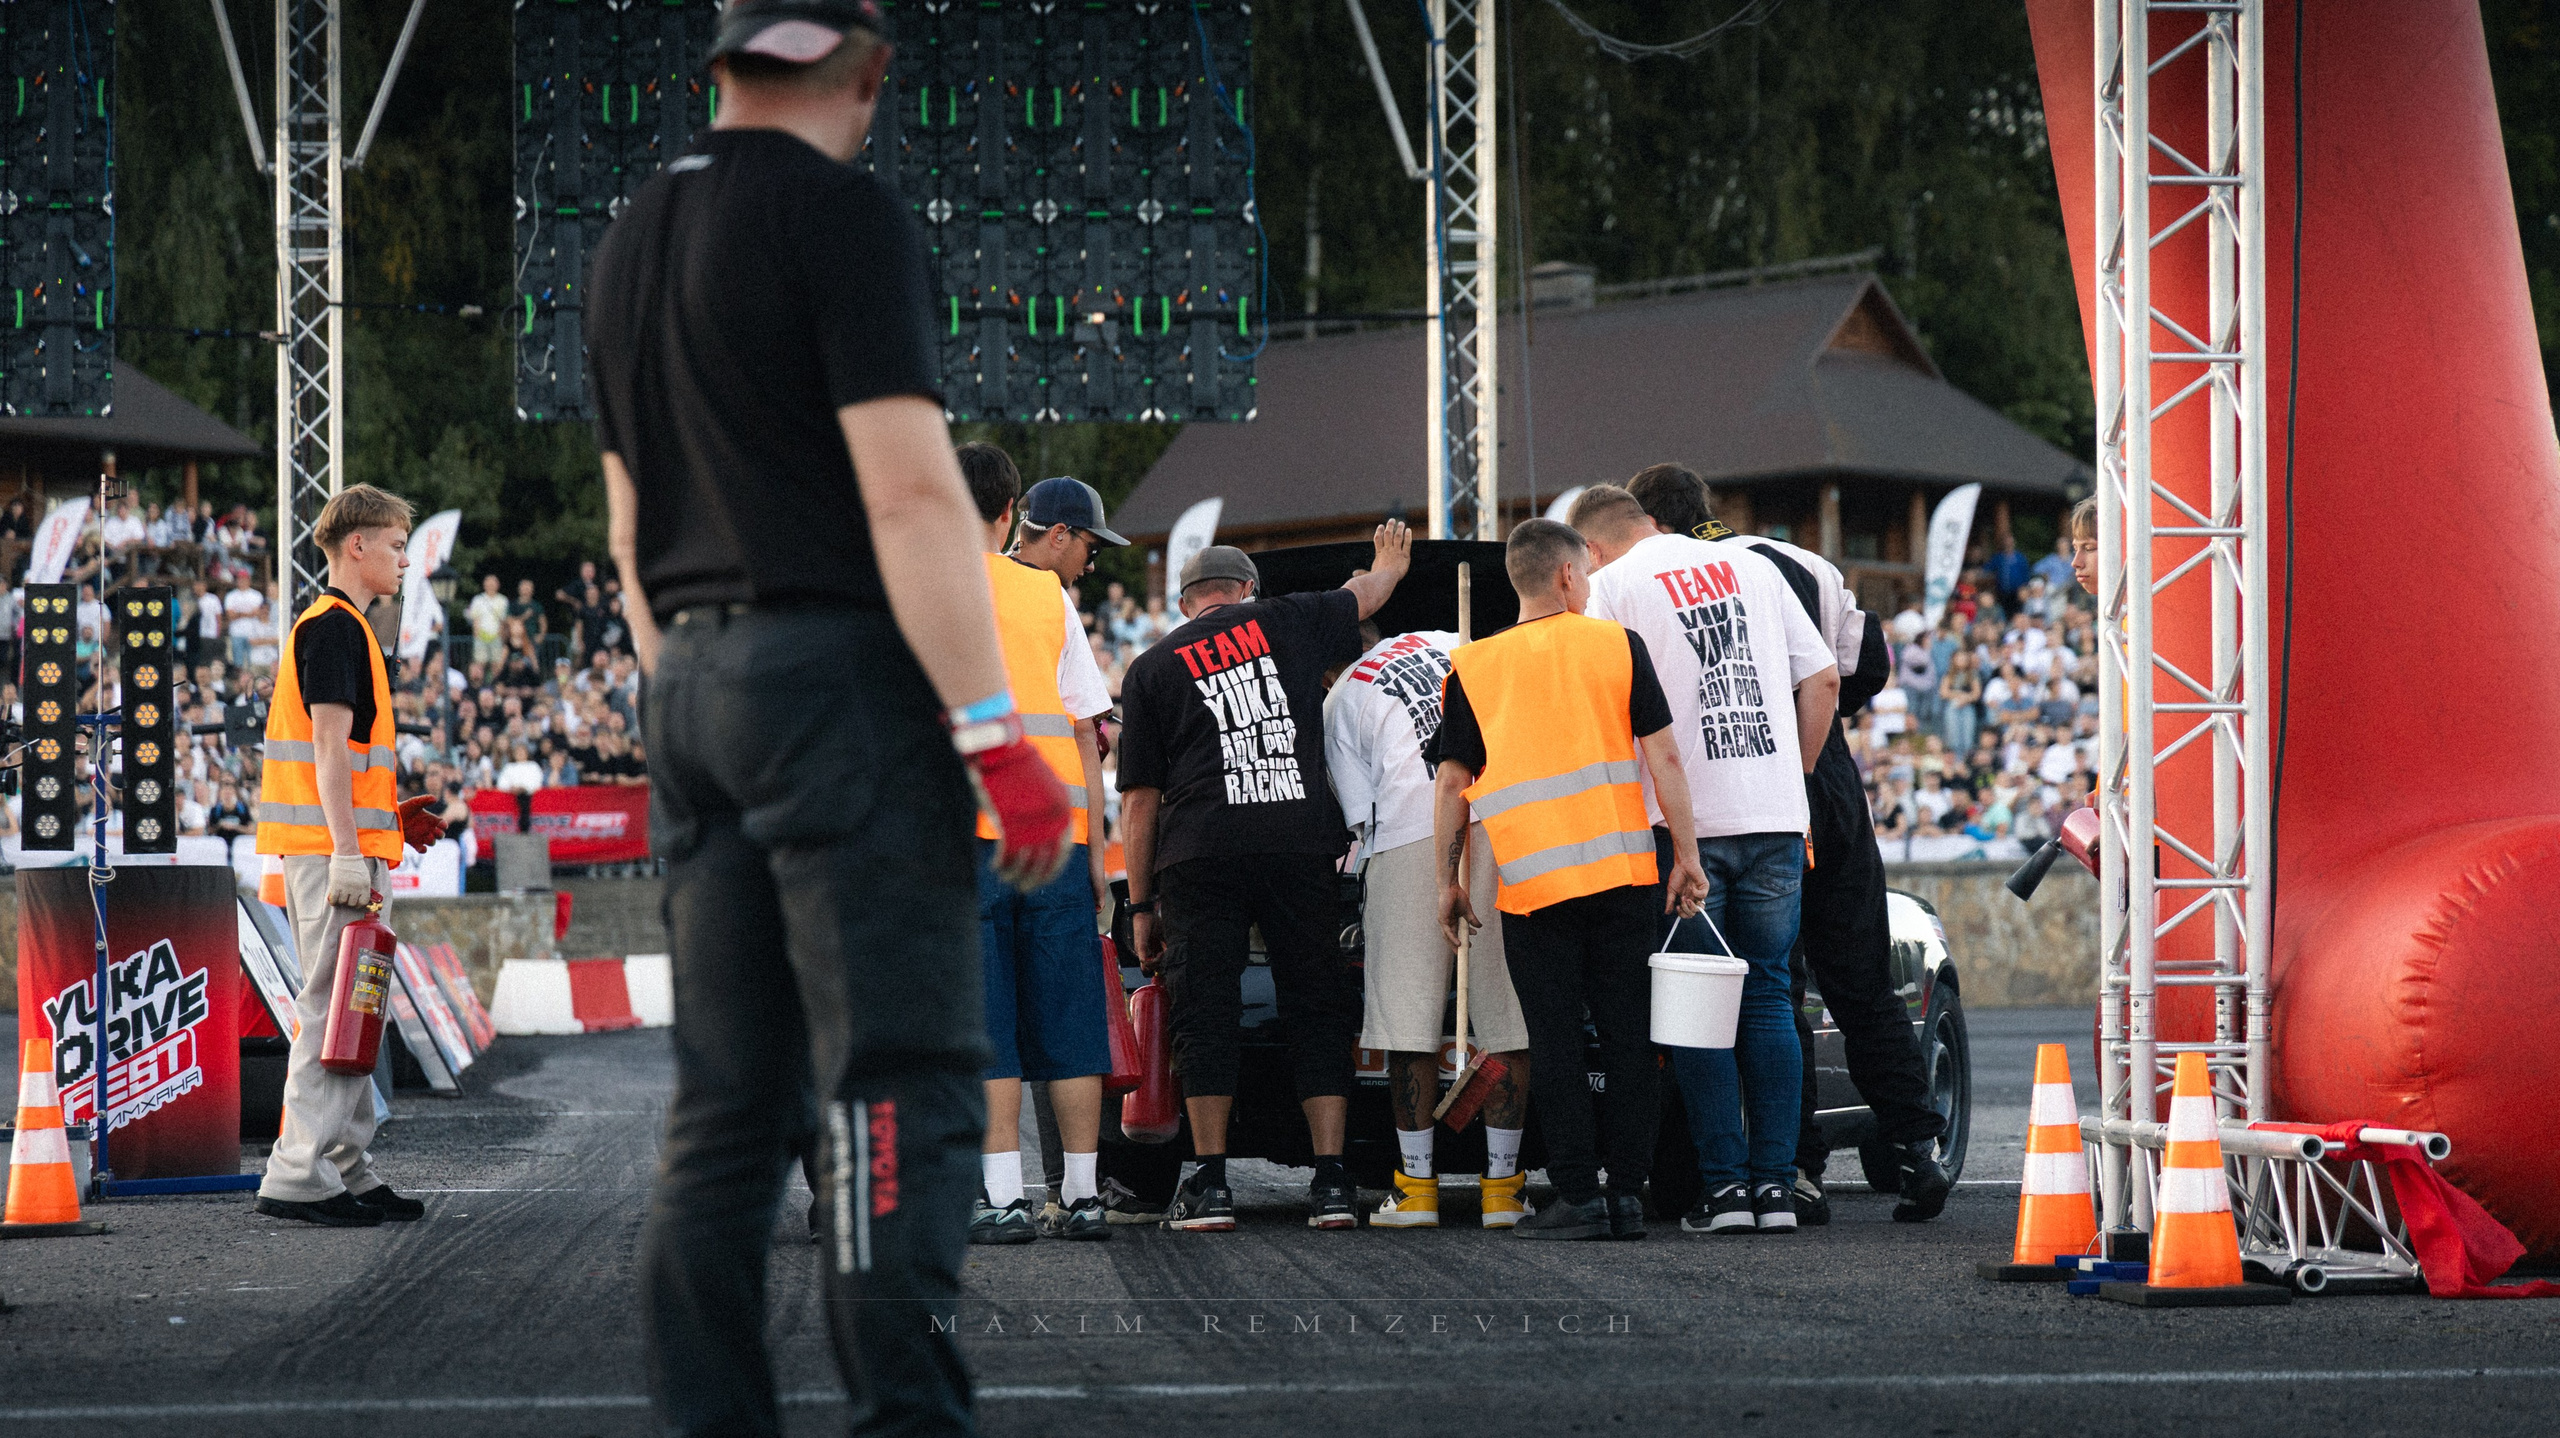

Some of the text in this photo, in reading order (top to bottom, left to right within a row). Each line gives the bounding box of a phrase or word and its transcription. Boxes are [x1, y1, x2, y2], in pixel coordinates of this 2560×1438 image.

[1654, 560, 1741, 609] TEAM
[1174, 619, 1271, 679] TEAM
[1347, 634, 1432, 684] TEAM
[1684, 614, 1754, 669] YUKA
[1203, 674, 1291, 732] YUKA
[1735, 674, 1764, 707] PRO
[1263, 725, 1297, 756] PRO
[1702, 720, 1777, 761] RACING
[1224, 767, 1306, 805] RACING
[46, 943, 180, 1042] YUKA
[56, 972, 206, 1088] DRIVE
[63, 1031, 188, 1126] FEST
